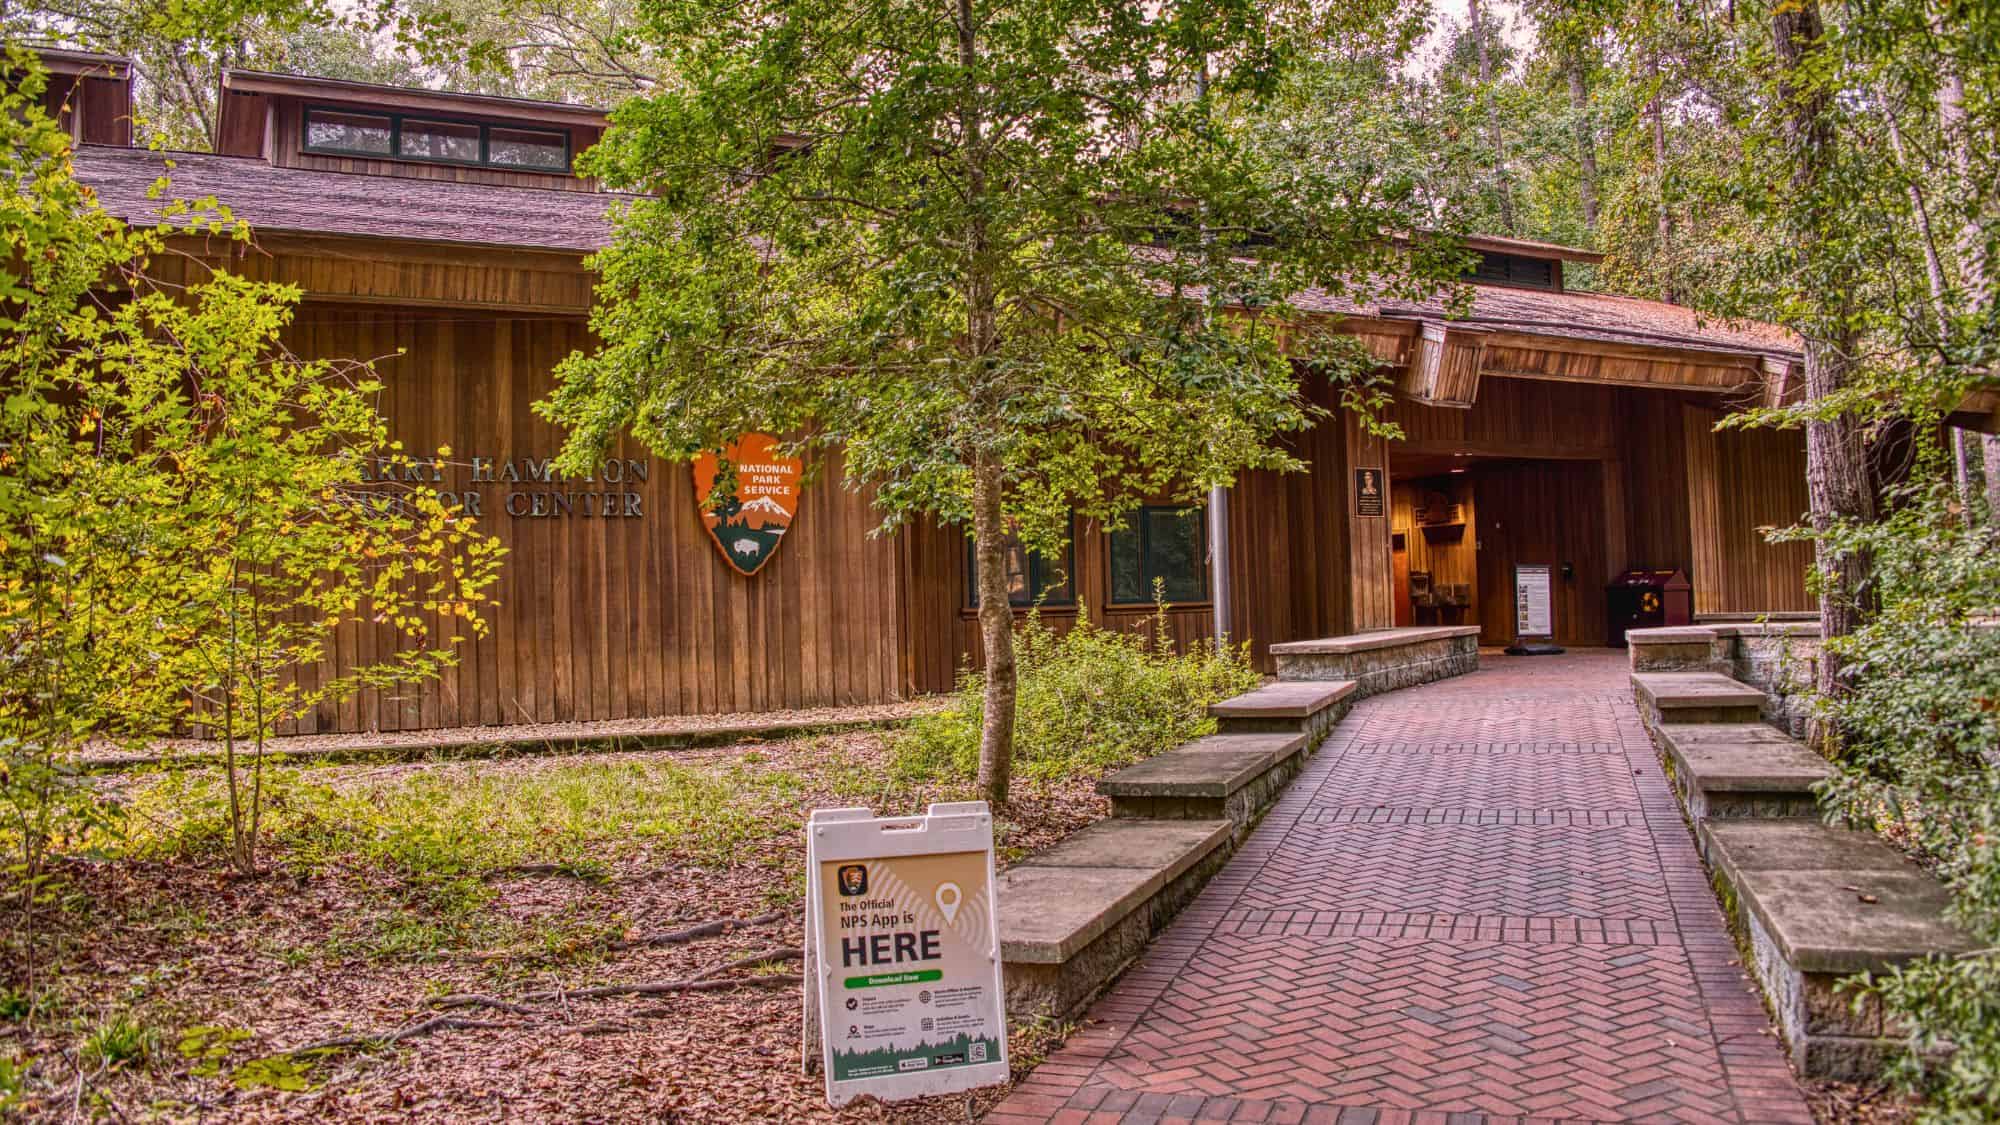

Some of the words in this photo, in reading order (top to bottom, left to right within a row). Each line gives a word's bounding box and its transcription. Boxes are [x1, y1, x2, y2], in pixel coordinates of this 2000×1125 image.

[739, 463, 793, 474] NATIONAL
[752, 474, 781, 485] PARK
[743, 485, 791, 495] SERVICE
[506, 491, 644, 517] CENTER
[840, 902, 857, 913] The
[860, 898, 895, 911] Official
[841, 914, 868, 929] NPS
[871, 914, 899, 930] App
[902, 911, 914, 925] is
[841, 929, 942, 968] HERE
